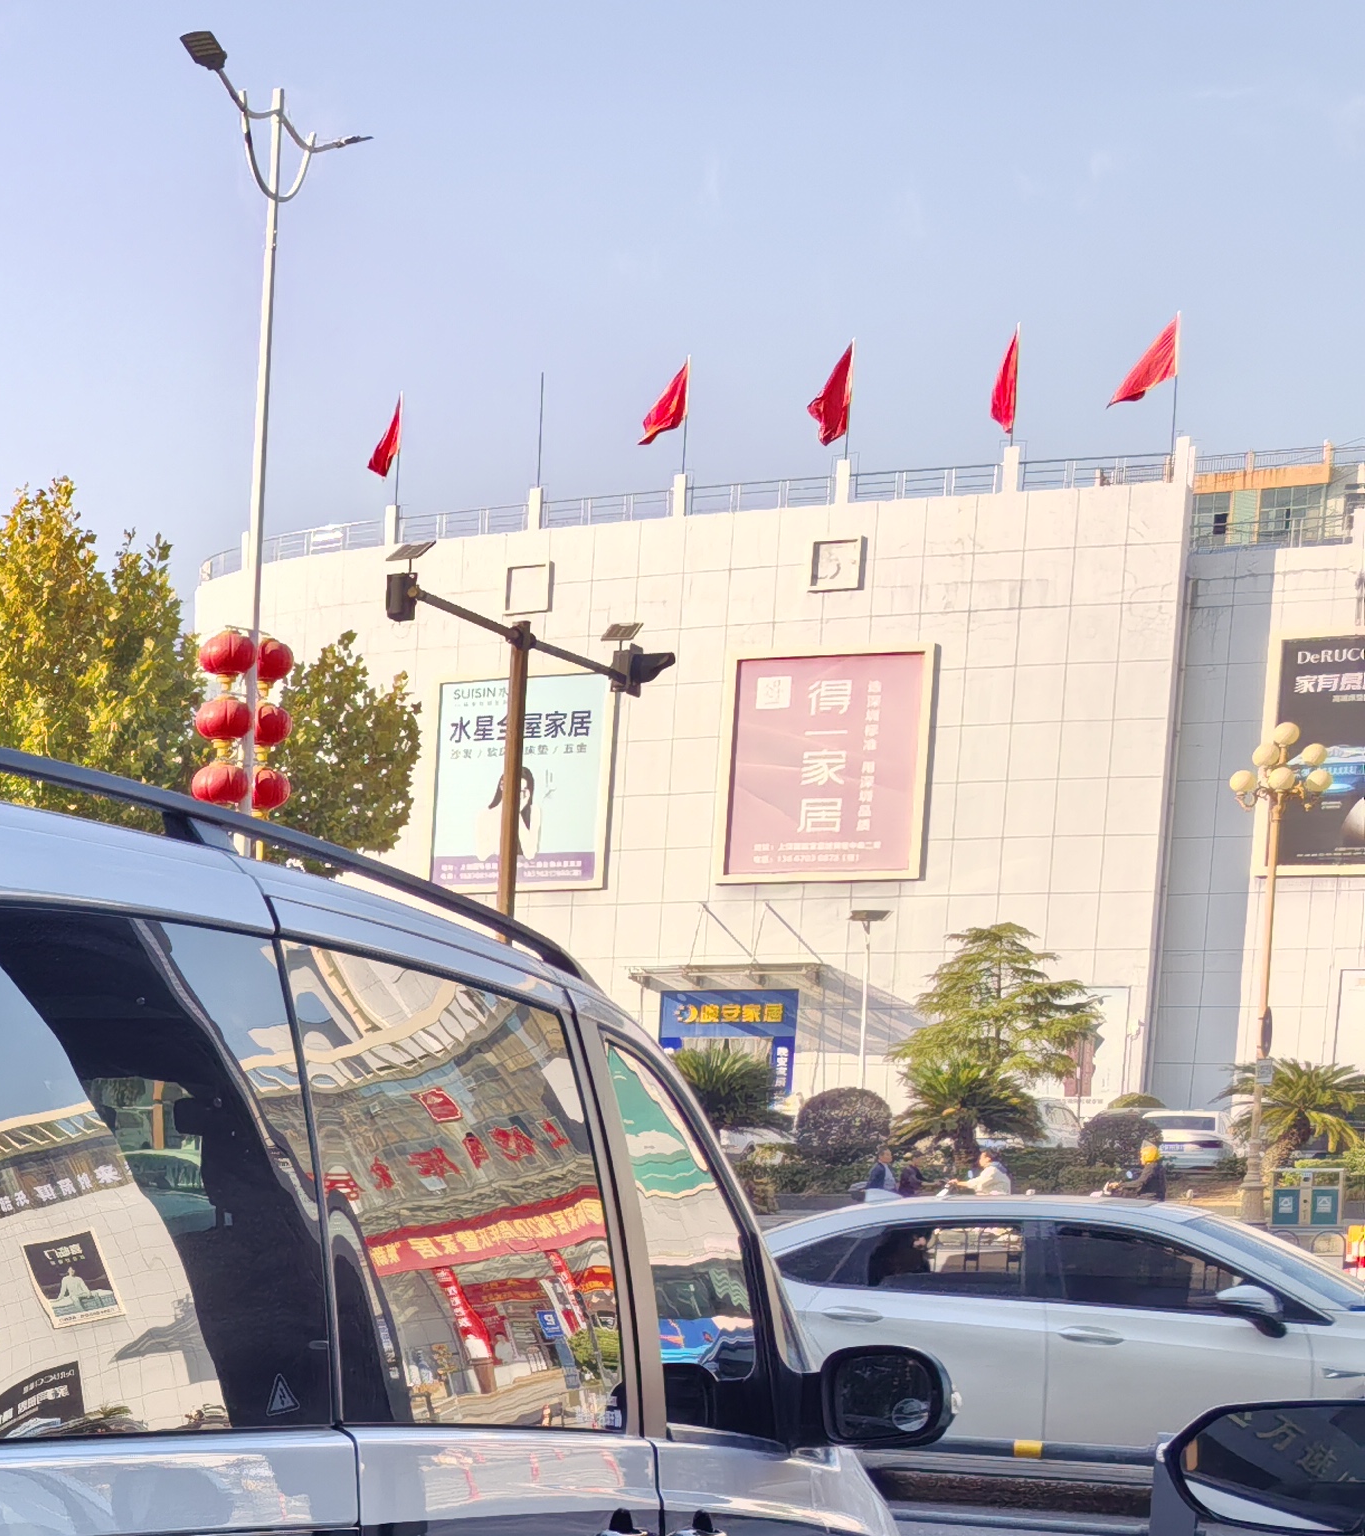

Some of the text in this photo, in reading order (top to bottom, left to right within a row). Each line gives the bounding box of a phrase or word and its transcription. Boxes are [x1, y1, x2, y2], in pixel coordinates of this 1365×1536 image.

[1297, 648, 1365, 665] DeRUC
[453, 687, 496, 701] SUISIN
[797, 679, 853, 834] 得一家居
